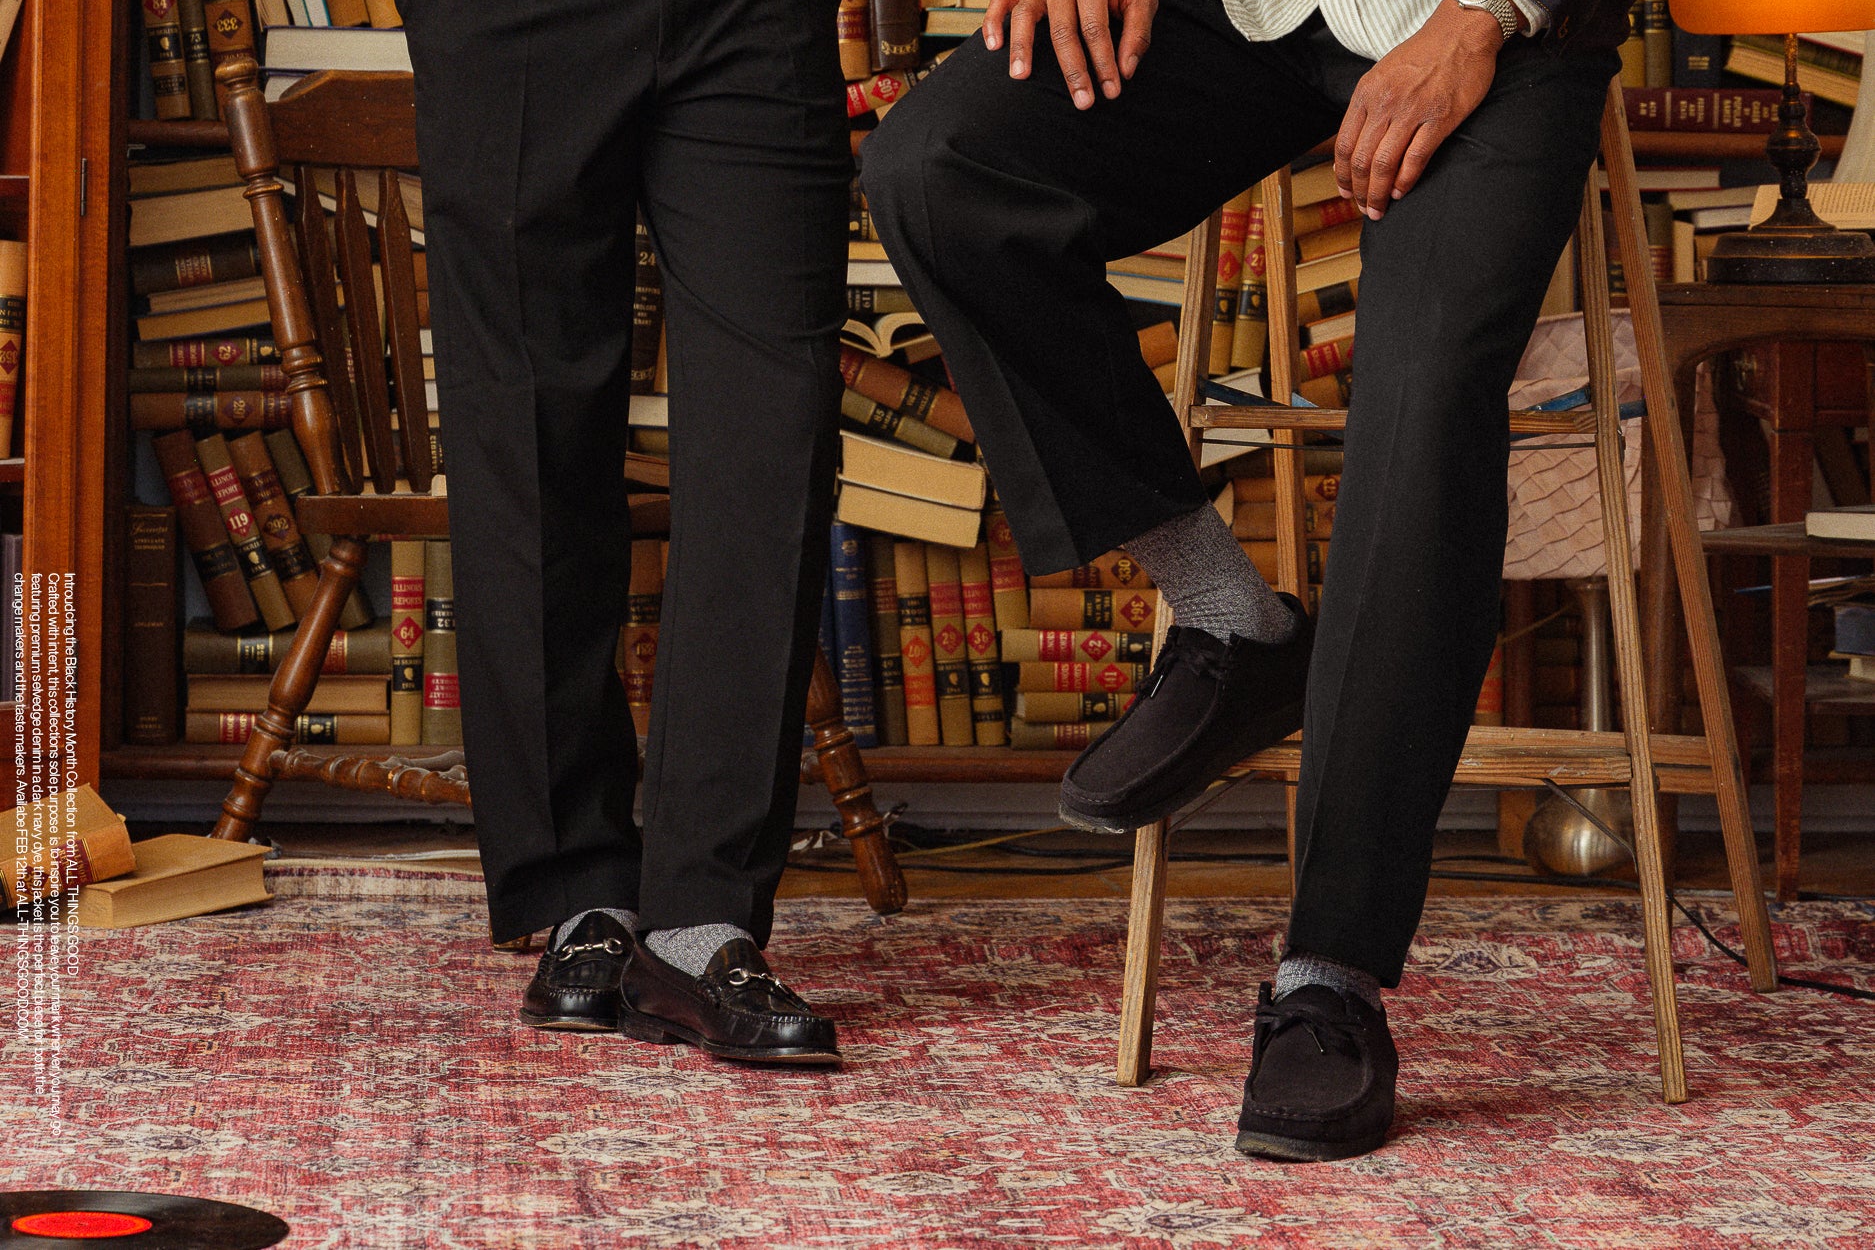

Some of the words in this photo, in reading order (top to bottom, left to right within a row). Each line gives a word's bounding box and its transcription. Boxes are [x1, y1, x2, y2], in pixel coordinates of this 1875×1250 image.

[216, 17, 239, 32] 333
[878, 79, 893, 99] 105
[639, 251, 656, 266] 24
[228, 512, 250, 531] 119
[1119, 559, 1130, 582] 330
[1131, 601, 1143, 622] 364
[400, 625, 415, 640] 64
[972, 632, 988, 644] 36
[1105, 670, 1117, 688] 141
